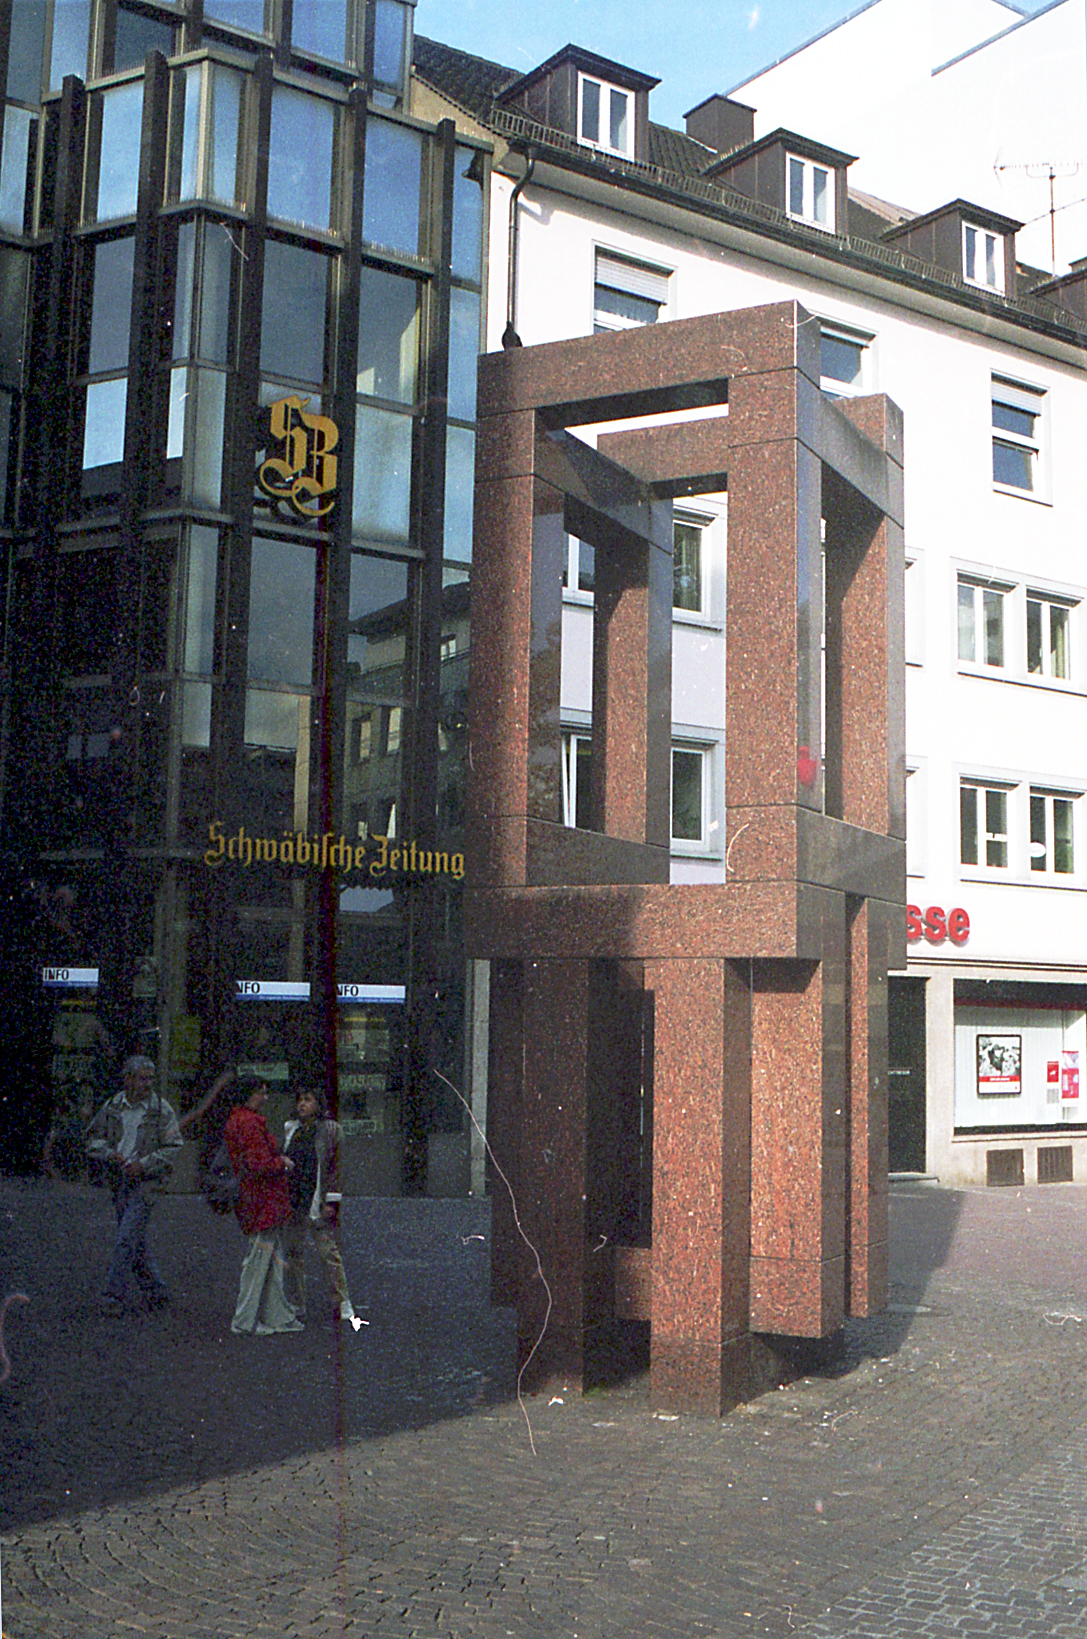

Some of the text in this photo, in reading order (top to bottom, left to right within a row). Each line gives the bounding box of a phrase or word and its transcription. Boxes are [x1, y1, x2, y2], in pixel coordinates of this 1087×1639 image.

[204, 821, 465, 880] Schwäbische Zeitung
[906, 904, 970, 942] sse
[44, 969, 70, 981] INFO
